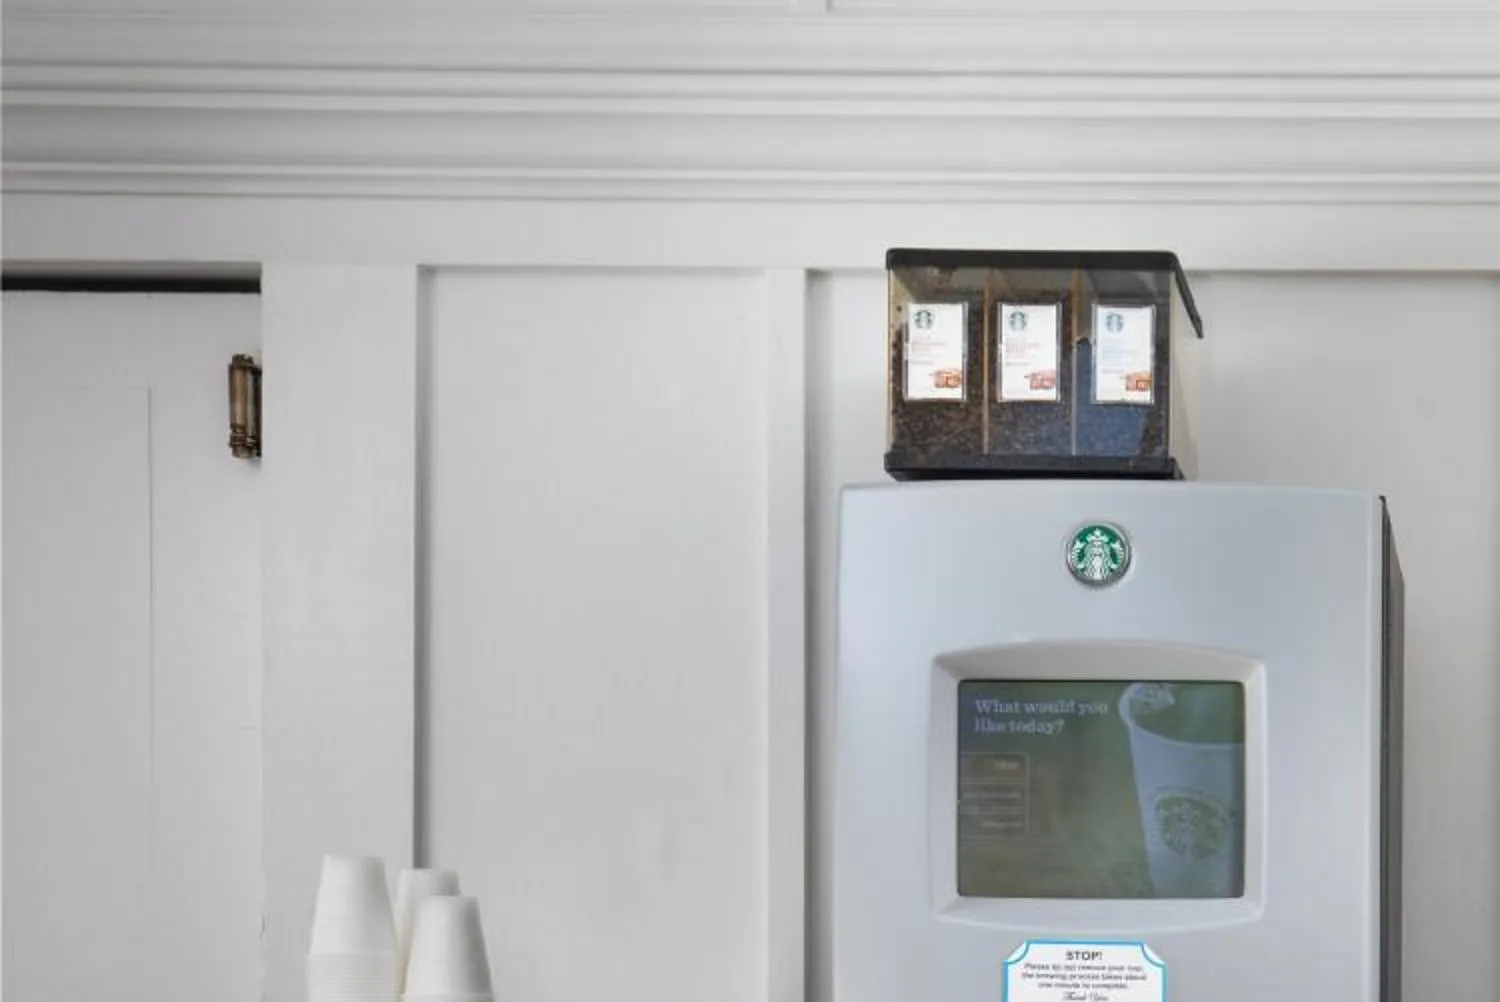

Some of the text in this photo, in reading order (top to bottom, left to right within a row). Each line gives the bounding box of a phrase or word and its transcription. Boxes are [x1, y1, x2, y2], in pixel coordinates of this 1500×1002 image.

[974, 699, 1108, 716] What would you
[974, 717, 1065, 735] like today?
[1065, 951, 1103, 961] STOP!
